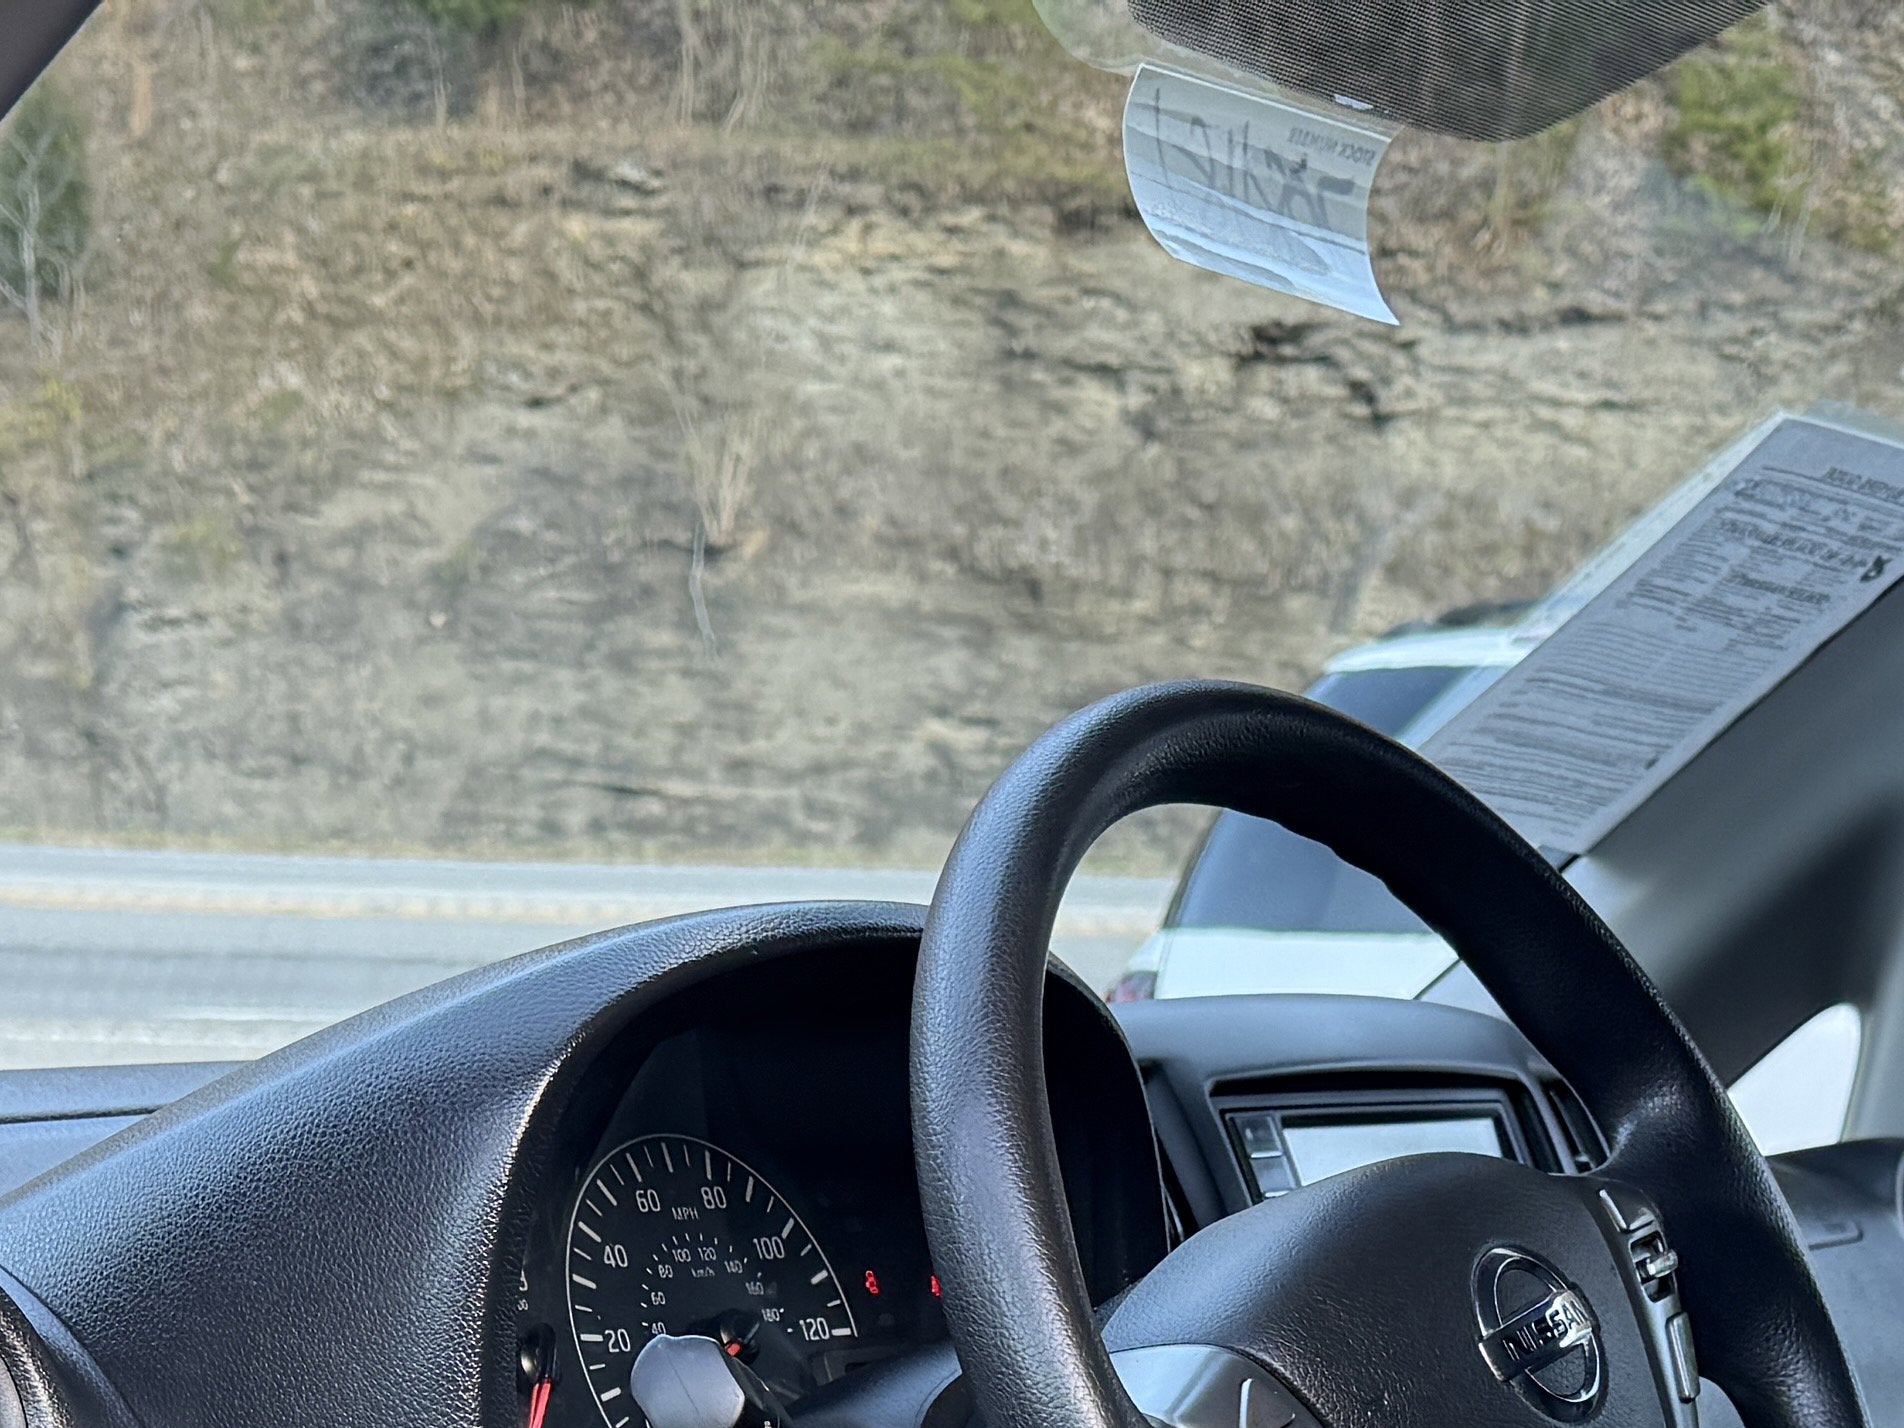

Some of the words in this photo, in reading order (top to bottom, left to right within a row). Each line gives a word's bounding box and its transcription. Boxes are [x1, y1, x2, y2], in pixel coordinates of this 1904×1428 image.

[636, 1189, 660, 1212] 60
[700, 1186, 727, 1209] 80
[672, 1206, 699, 1220] MPH
[604, 1244, 628, 1268] 40
[672, 1248, 691, 1263] 100
[698, 1247, 717, 1261] 120
[753, 1236, 785, 1259] 100
[658, 1264, 673, 1278] 80
[651, 1291, 666, 1305] 60
[799, 1317, 830, 1341] 120
[1502, 1298, 1590, 1361] NISSAN
[605, 1330, 631, 1353] 20
